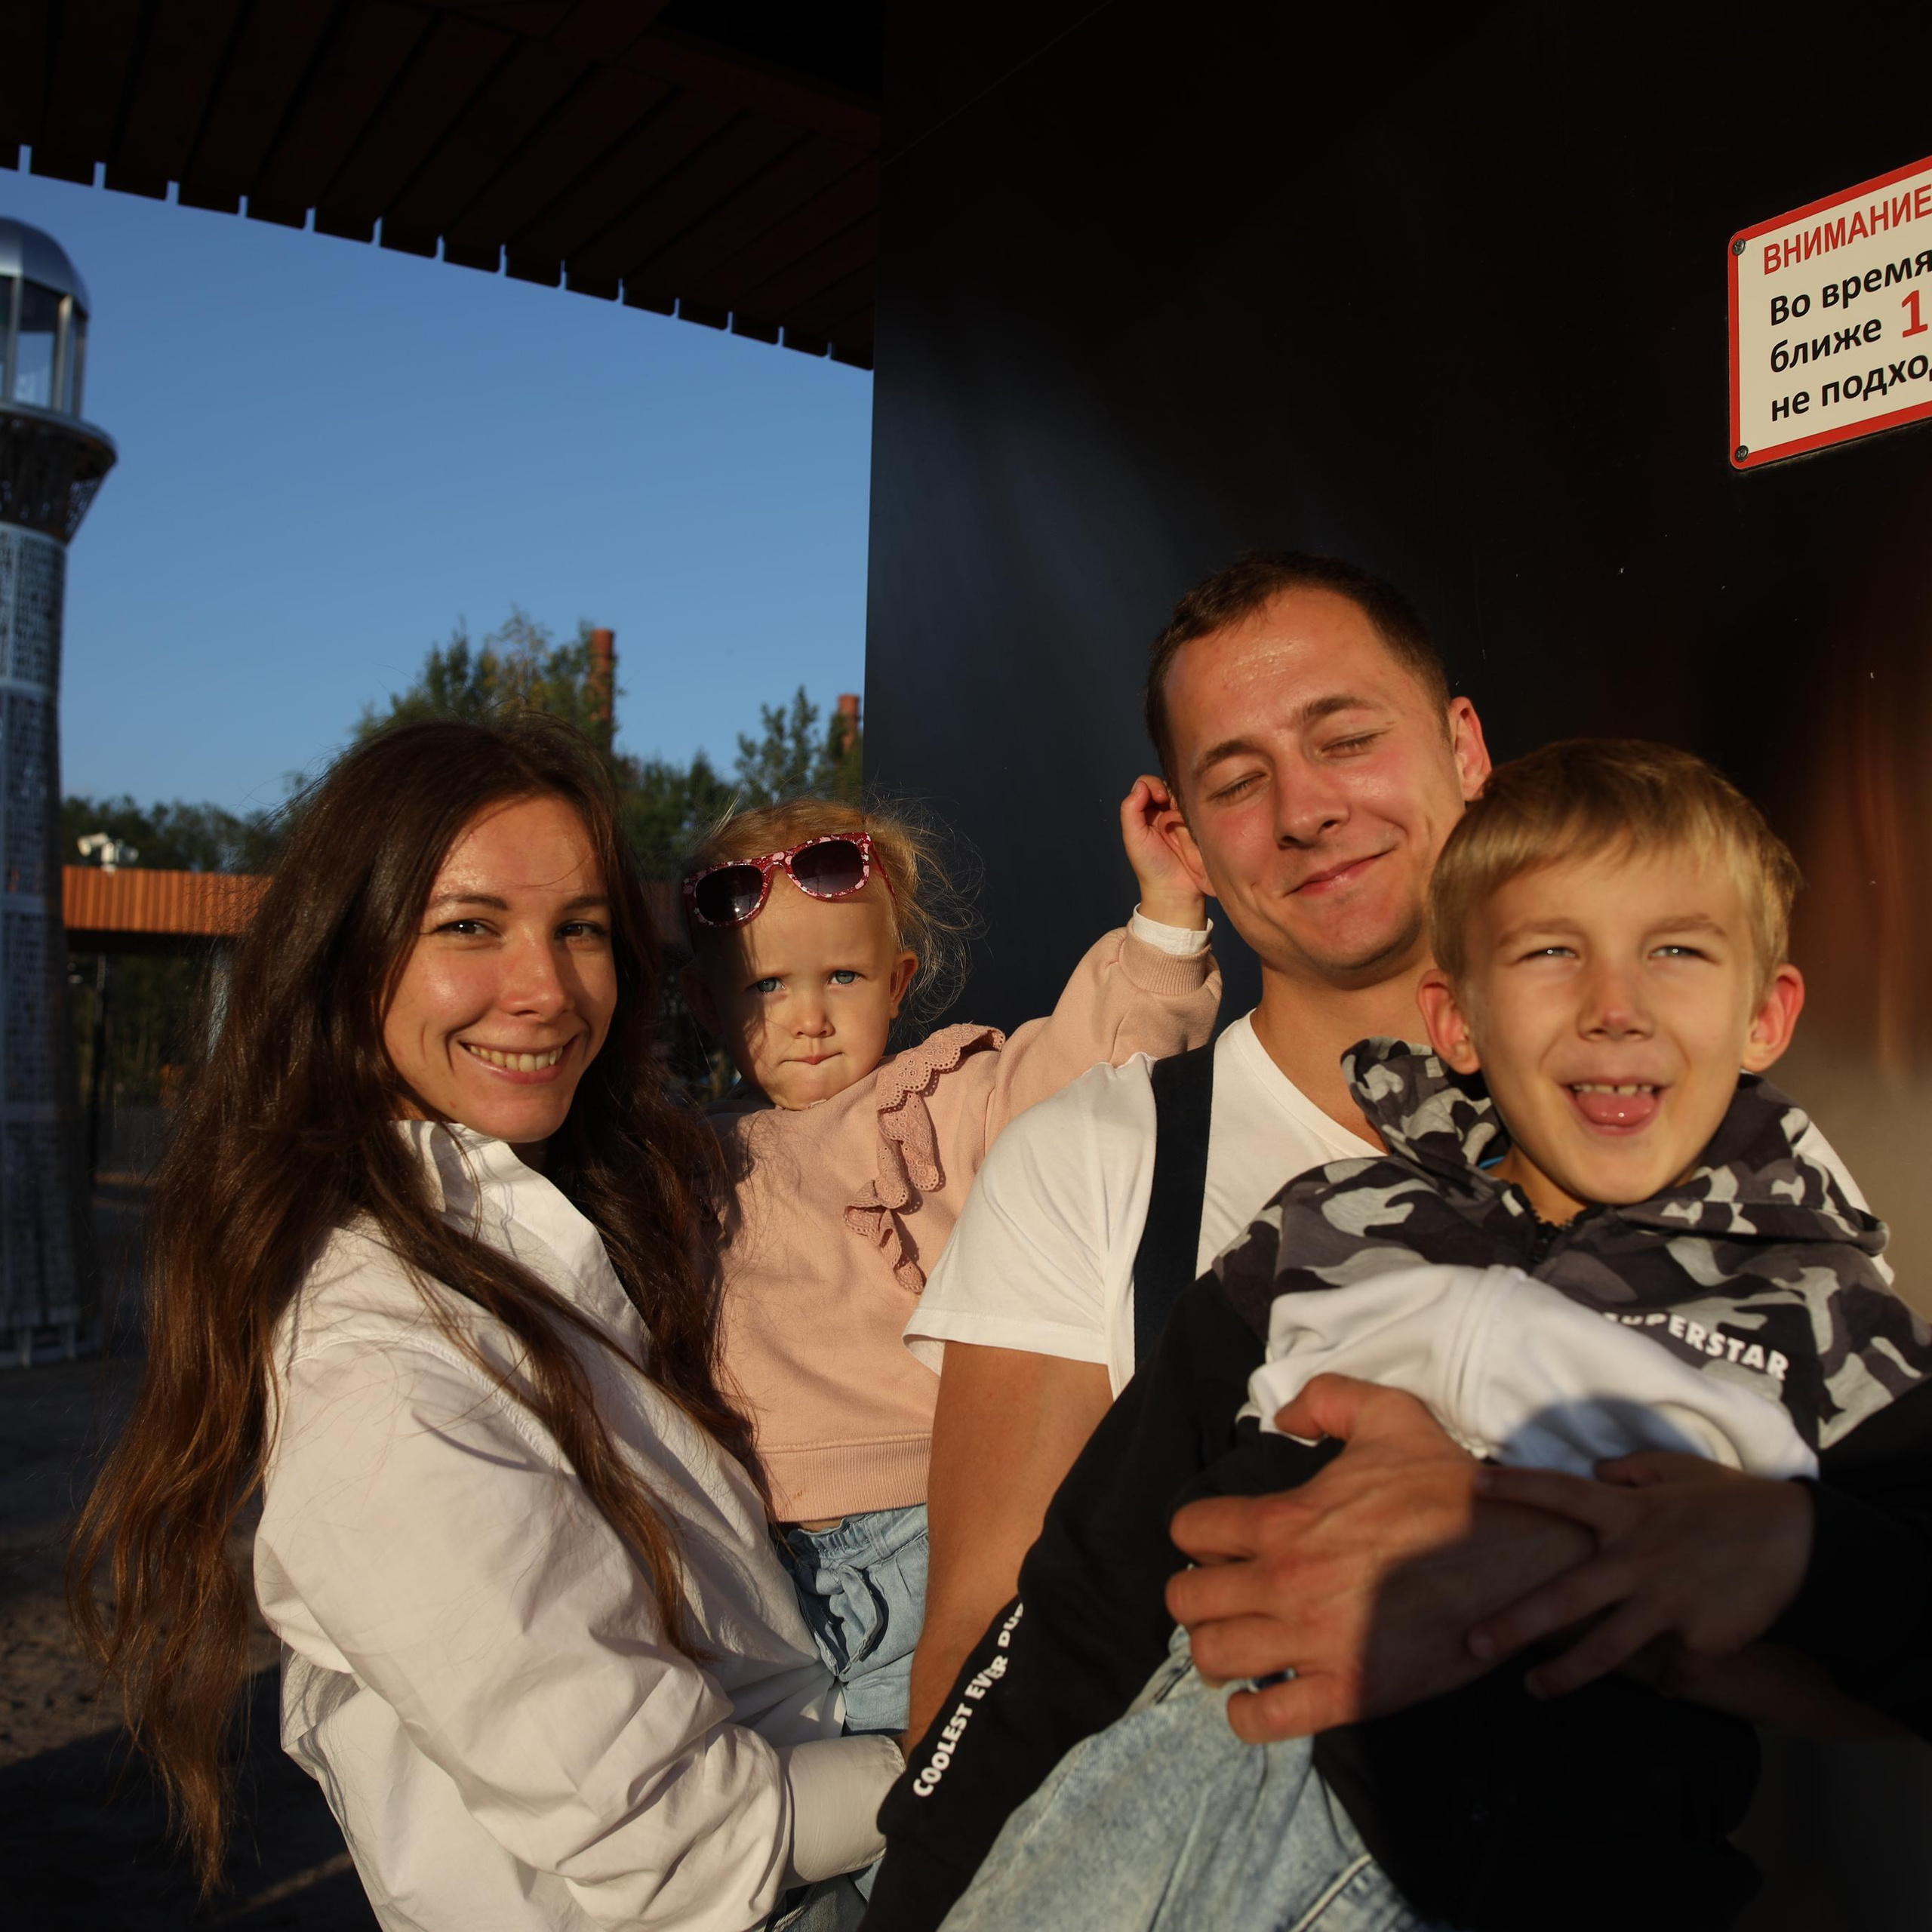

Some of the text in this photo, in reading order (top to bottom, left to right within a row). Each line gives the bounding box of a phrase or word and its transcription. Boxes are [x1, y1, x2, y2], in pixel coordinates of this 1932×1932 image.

[1764, 183, 1932, 275] ВНИМАНИЕ
[1770, 249, 1932, 326] Во время
[1770, 289, 1929, 373] ближе 1
[1771, 353, 1932, 423] не подхо
[913, 1702, 973, 1797] COOLEST
[964, 1655, 1008, 1700] EVER
